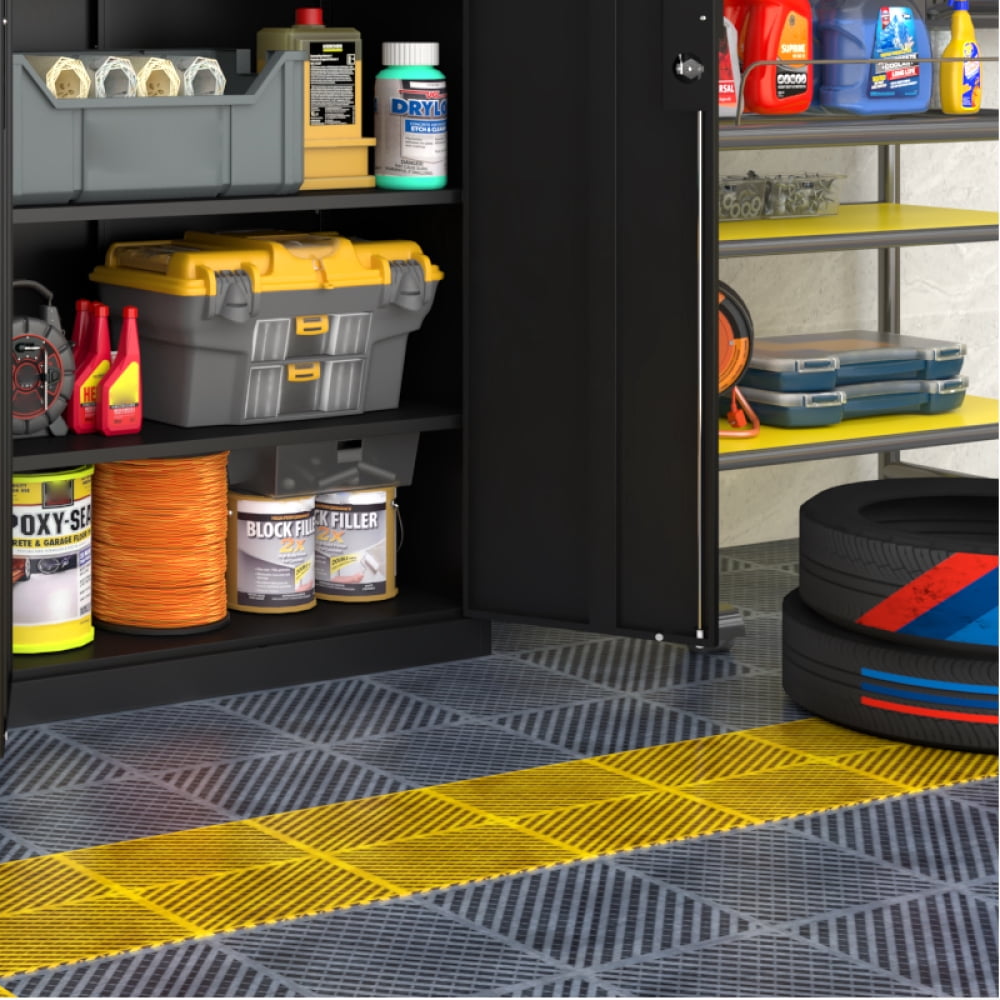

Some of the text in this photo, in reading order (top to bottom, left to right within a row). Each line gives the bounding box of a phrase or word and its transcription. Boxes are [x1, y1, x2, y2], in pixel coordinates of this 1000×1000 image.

[330, 511, 378, 530] FILLER
[247, 521, 292, 538] BLOCK
[44, 535, 72, 546] GARAGE
